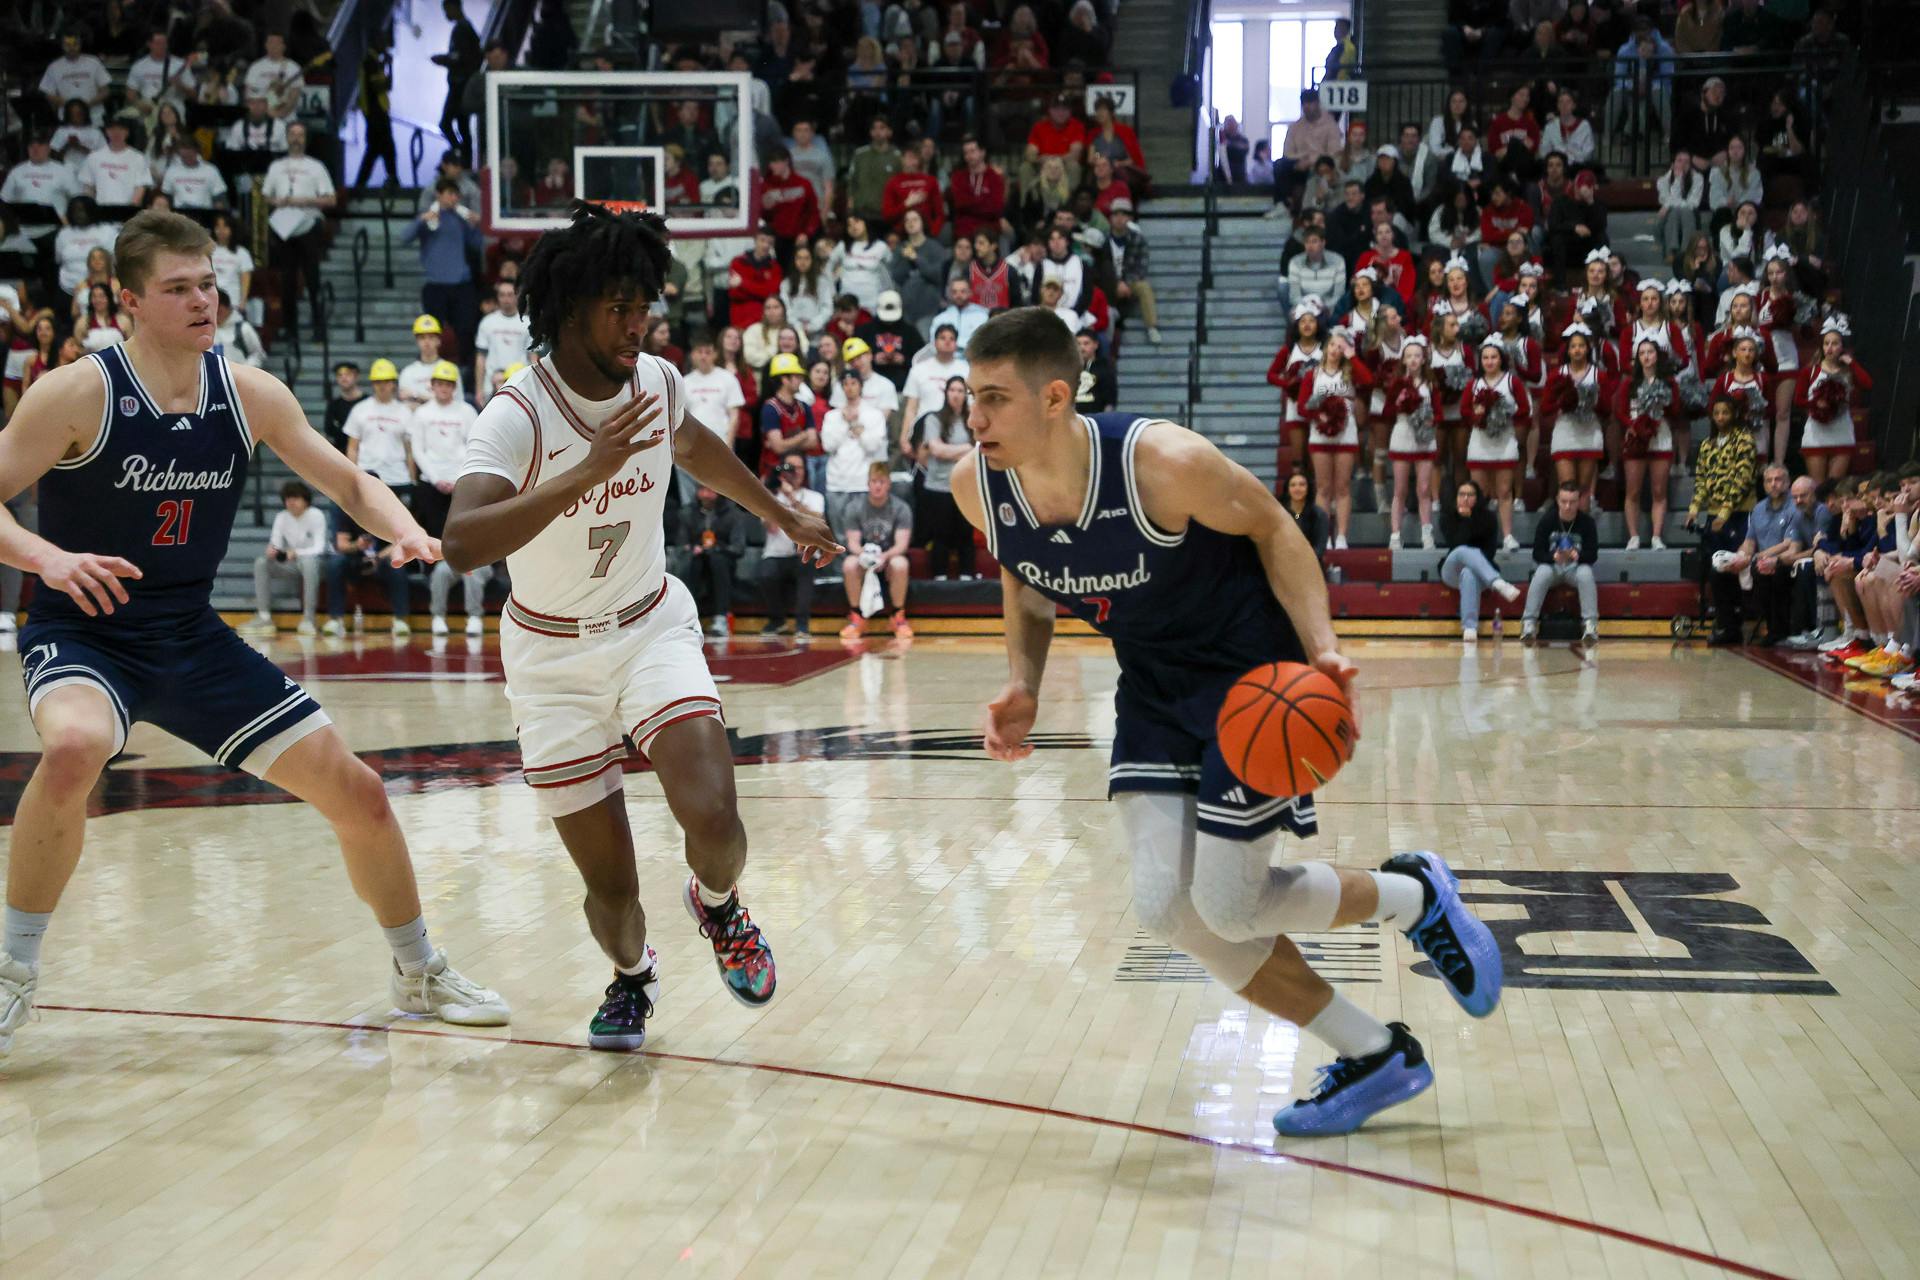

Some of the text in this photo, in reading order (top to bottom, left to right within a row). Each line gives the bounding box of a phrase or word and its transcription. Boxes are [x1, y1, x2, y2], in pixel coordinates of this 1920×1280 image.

[1327, 86, 1359, 106] 118
[114, 453, 235, 491] Richmond
[151, 499, 194, 546] 21
[588, 520, 631, 579] 7
[1017, 553, 1151, 594] Richmond
[585, 620, 611, 630] HAWK
[1081, 596, 1112, 624] 7
